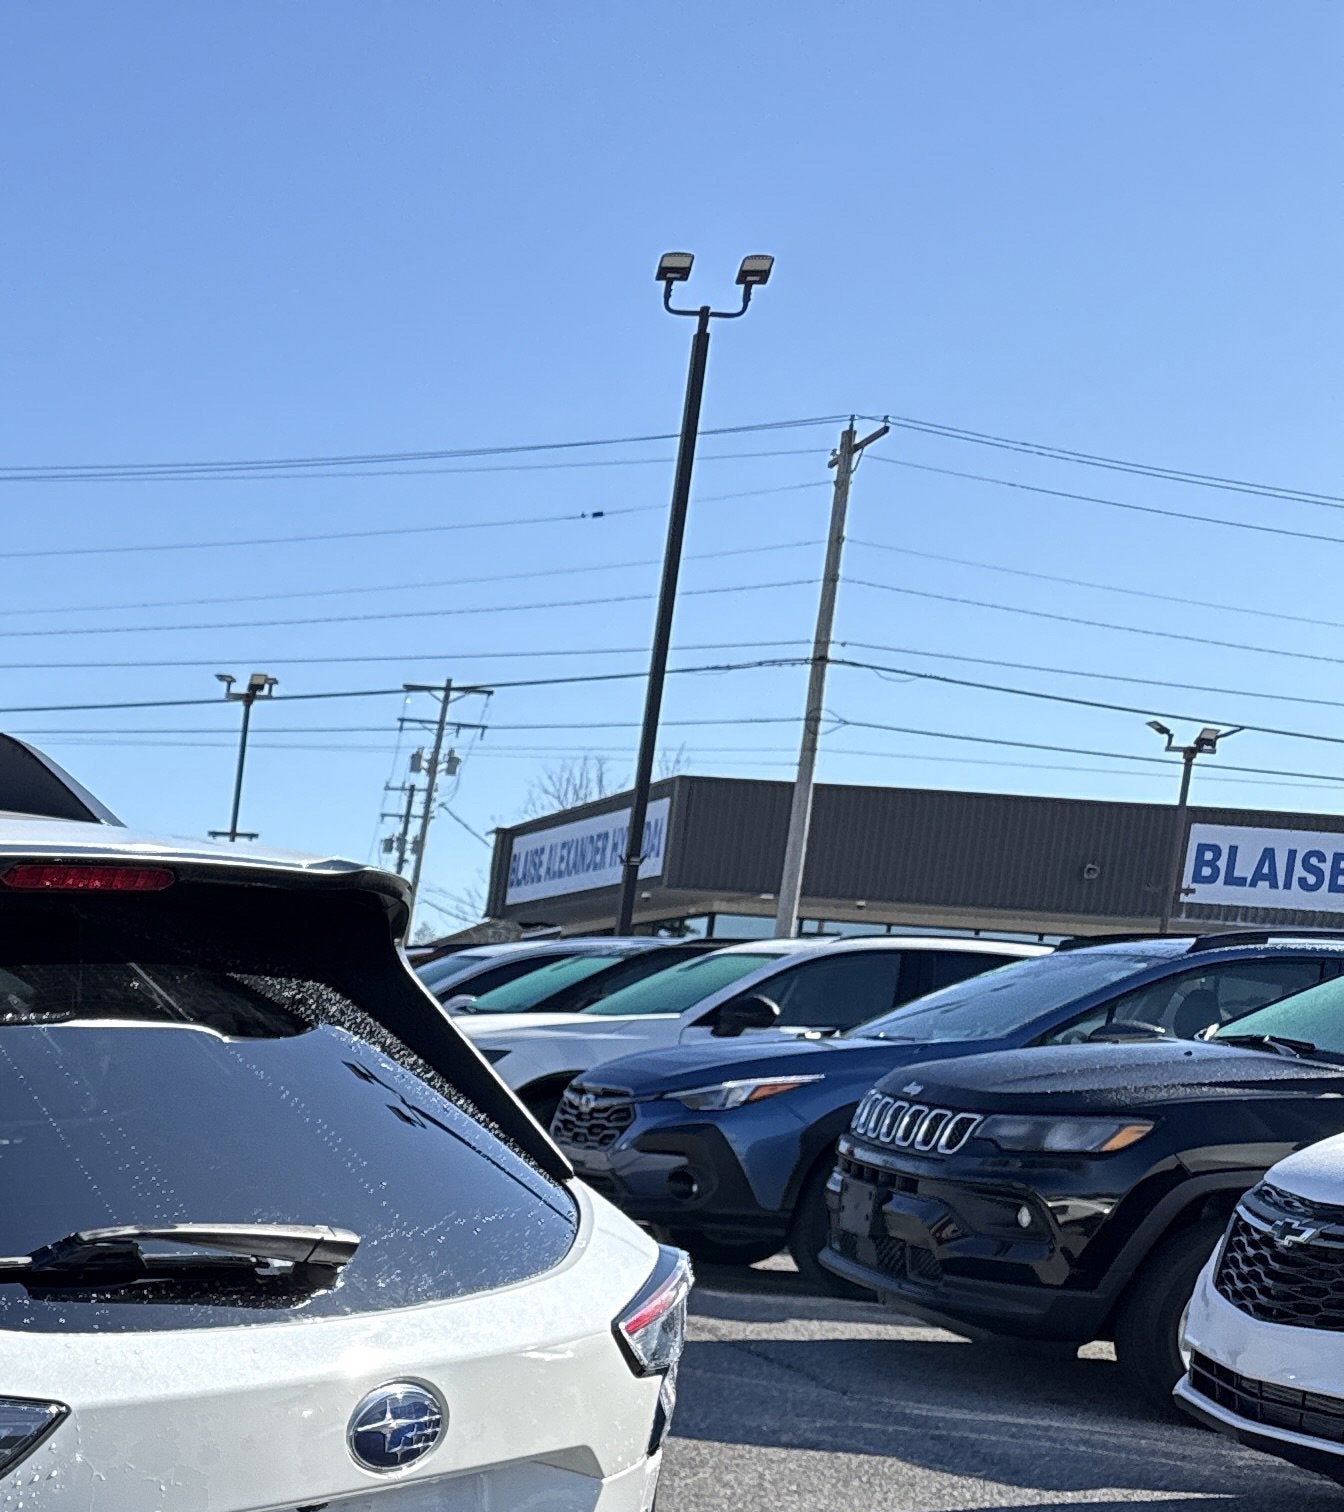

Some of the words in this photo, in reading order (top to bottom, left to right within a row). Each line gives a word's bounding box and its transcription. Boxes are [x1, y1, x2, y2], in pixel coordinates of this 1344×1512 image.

[511, 846, 545, 888] BLAISE
[543, 830, 610, 882] ALEXANDER
[1191, 842, 1344, 893] BLAISE
